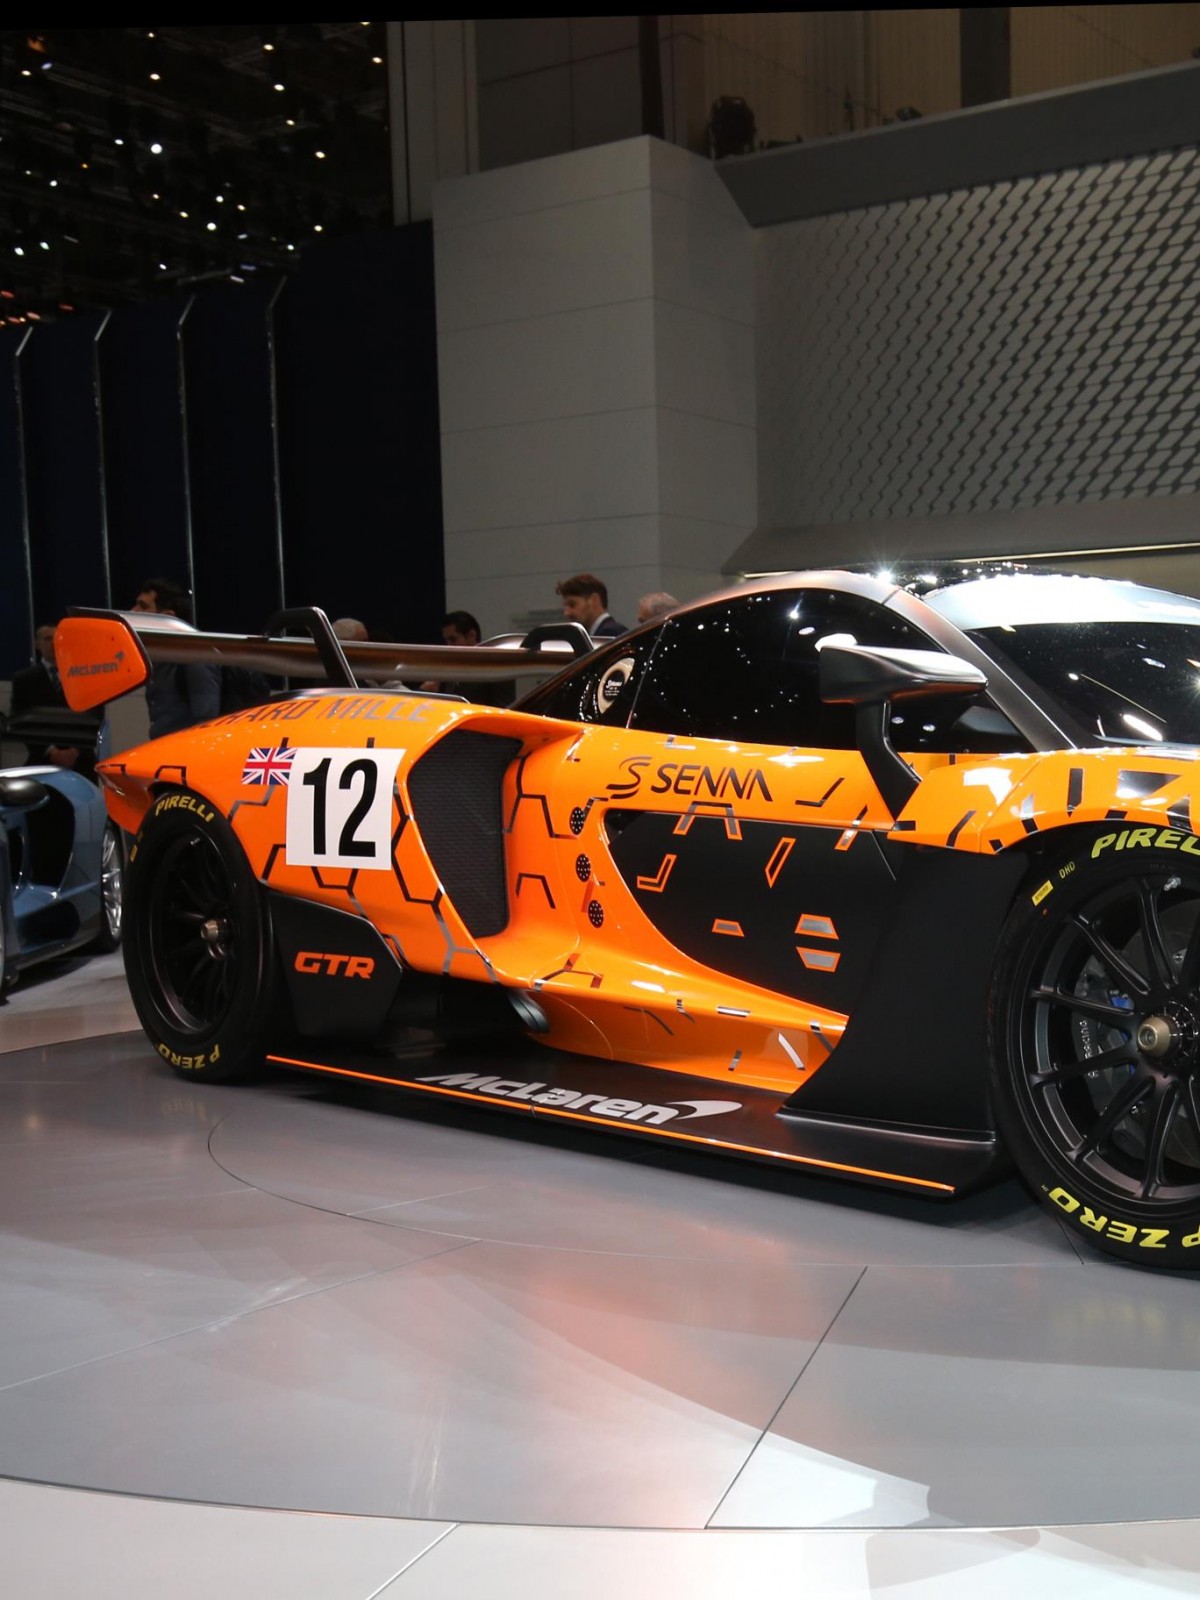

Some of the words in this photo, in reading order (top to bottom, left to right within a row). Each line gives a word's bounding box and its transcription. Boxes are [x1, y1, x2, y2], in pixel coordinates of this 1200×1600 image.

[317, 698, 437, 722] MILLE
[650, 764, 774, 802] SENNA
[155, 795, 216, 823] PIRELLI
[303, 757, 378, 858] 12
[295, 951, 376, 979] GTR
[158, 1042, 206, 1070] ZERO
[208, 1043, 221, 1064] P
[414, 1072, 681, 1126] McLaren
[1048, 1186, 1171, 1249] ZERO
